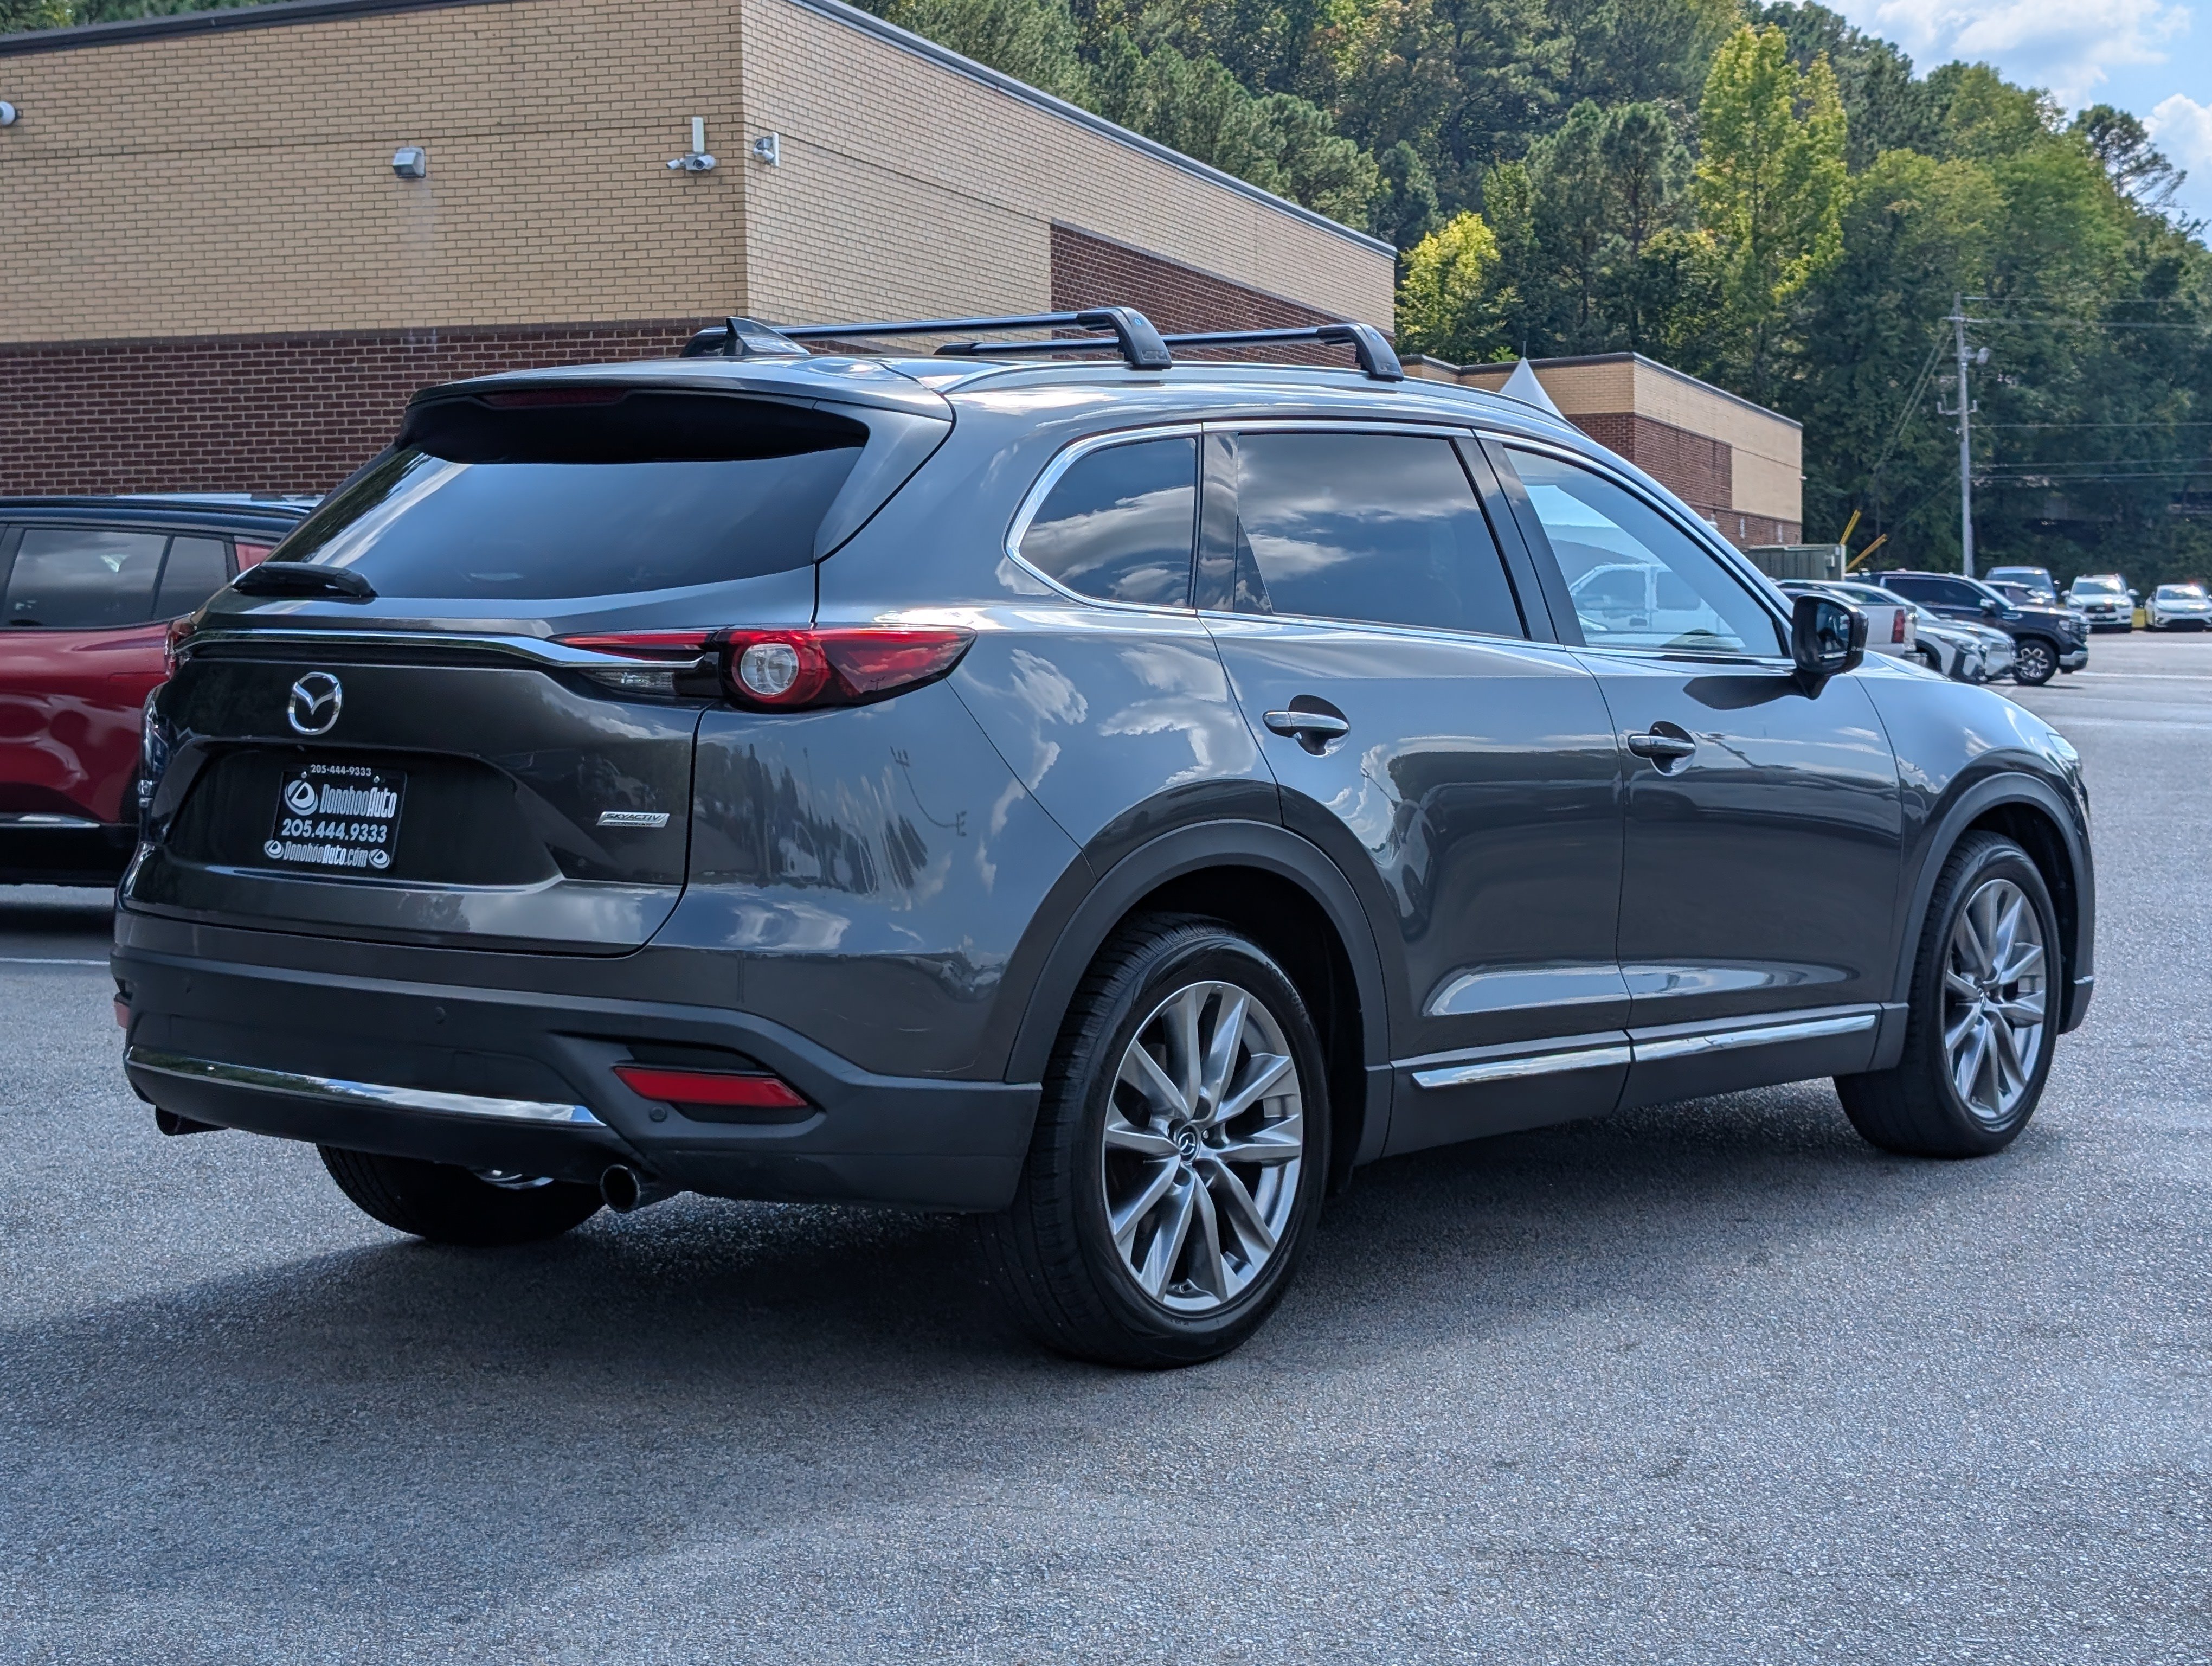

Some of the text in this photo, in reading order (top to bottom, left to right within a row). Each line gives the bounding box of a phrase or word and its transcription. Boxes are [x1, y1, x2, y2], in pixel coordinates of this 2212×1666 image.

[311, 764, 372, 777] 205-444-9333
[281, 818, 388, 843] 205.444.9333
[283, 841, 369, 867] DonohooAuto.com
